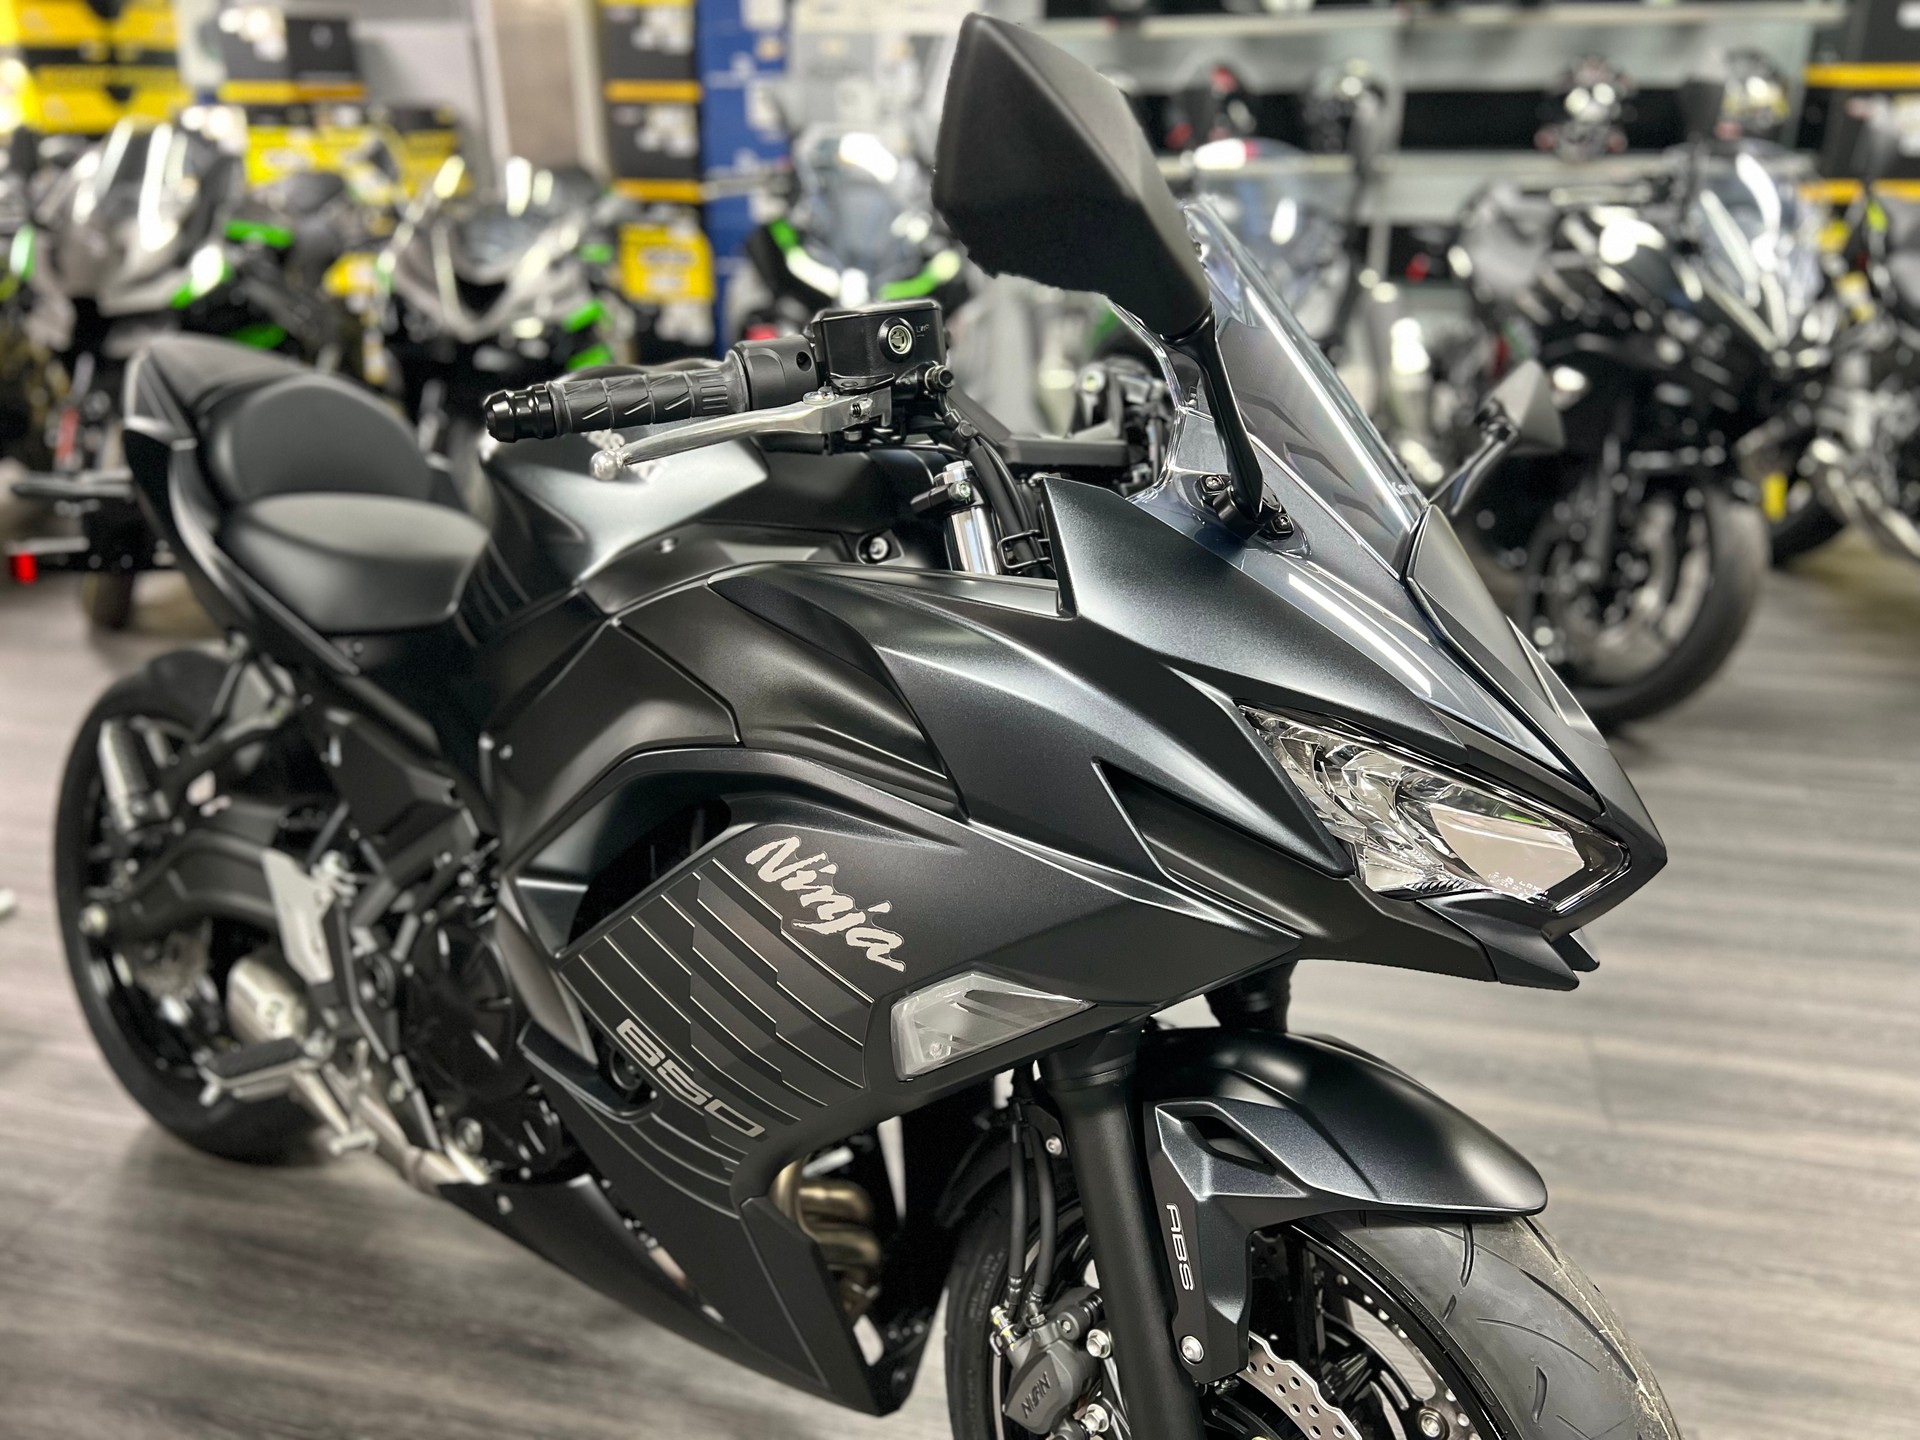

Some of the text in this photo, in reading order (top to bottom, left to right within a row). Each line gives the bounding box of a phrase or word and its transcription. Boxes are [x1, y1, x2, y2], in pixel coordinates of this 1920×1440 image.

[745, 836, 905, 972] Ninja
[616, 1018, 766, 1138] 650
[1165, 1202, 1194, 1292] ABS
